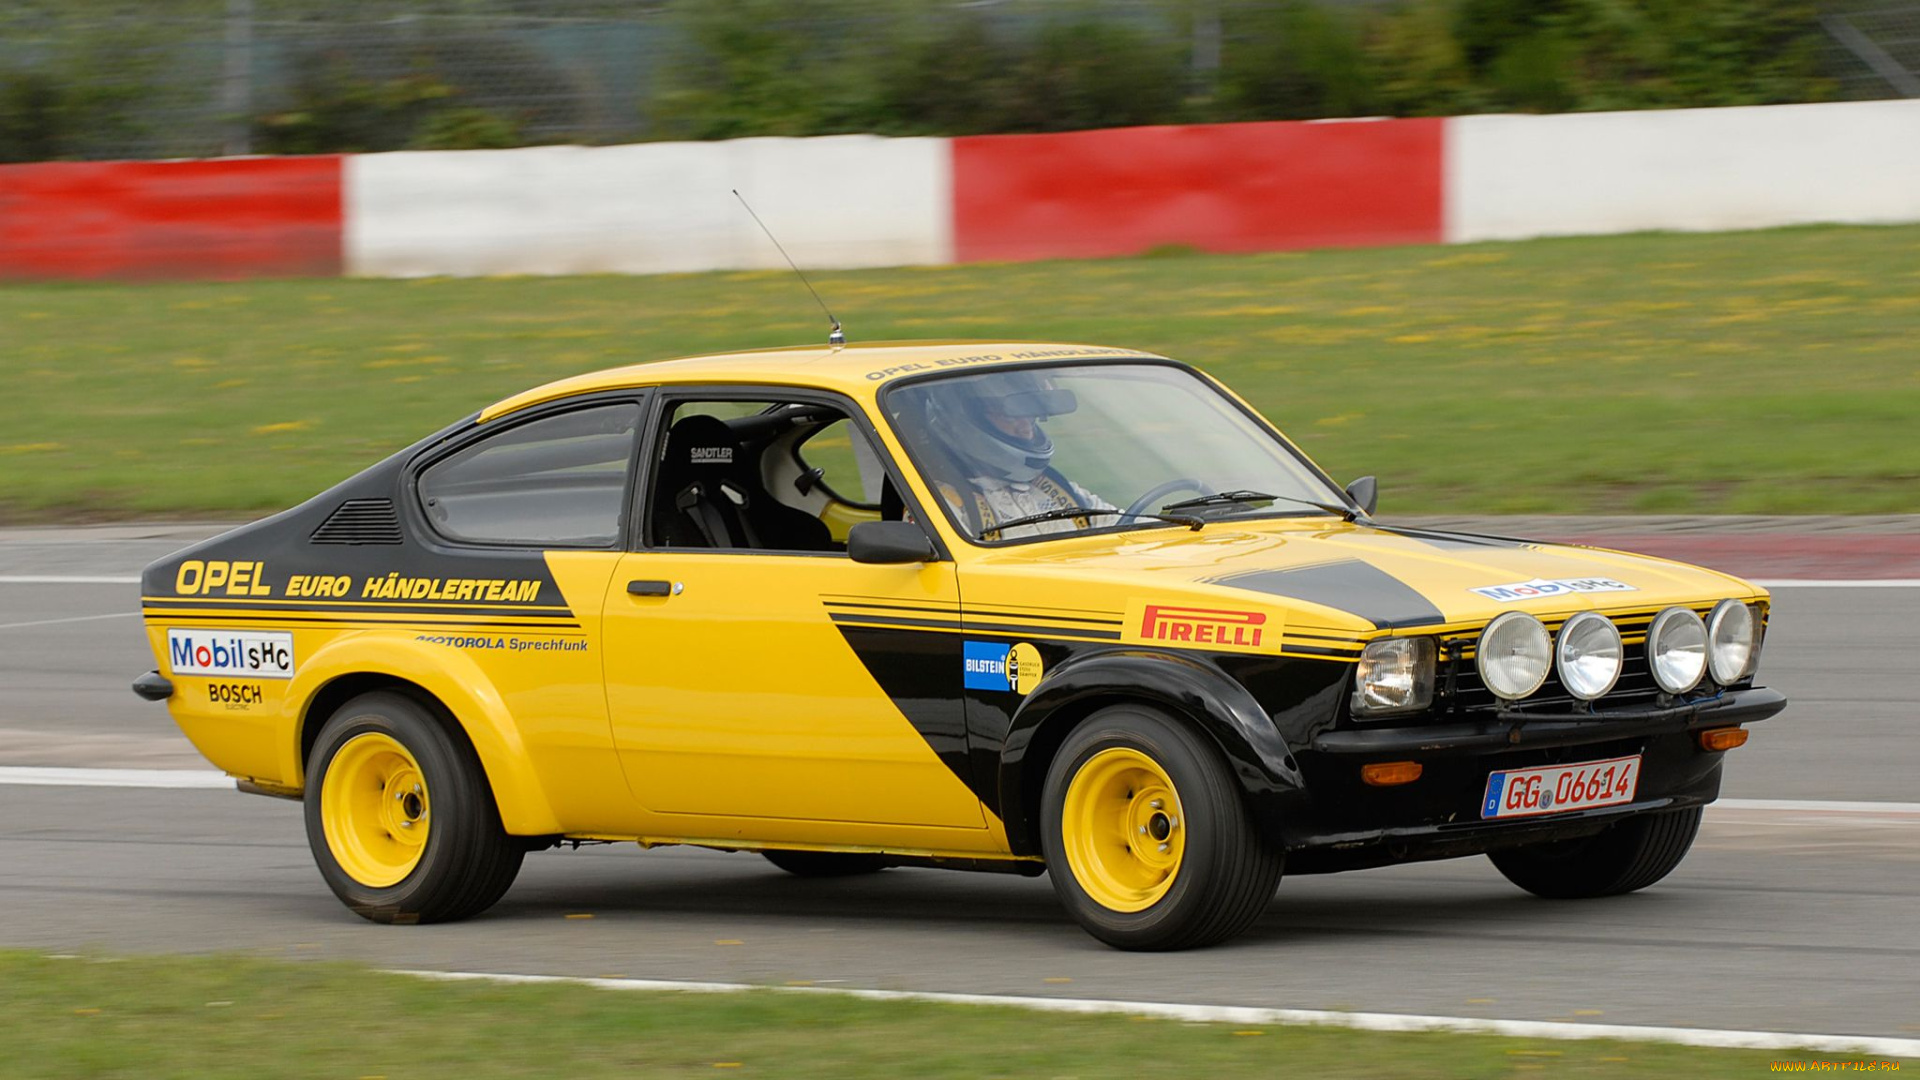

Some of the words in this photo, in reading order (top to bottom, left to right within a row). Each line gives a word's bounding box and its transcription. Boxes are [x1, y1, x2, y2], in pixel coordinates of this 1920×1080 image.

[865, 362, 932, 381] OPEL
[935, 355, 1003, 367] EURO
[690, 447, 733, 458] SANDTLER
[175, 560, 271, 596] OPEL
[285, 575, 352, 598] EURO
[361, 572, 542, 602] HÄNDLERTEAM
[1479, 581, 1578, 599] Mobl
[1140, 604, 1267, 647] PIRELLI
[171, 637, 245, 669] Mobil
[509, 638, 588, 652] Sprechfunk
[966, 658, 1005, 674] BILSTEIN
[208, 684, 262, 704] BOSCH
[1488, 799, 1496, 810] D
[1506, 775, 1542, 810] GG
[1554, 763, 1632, 805] 06614
